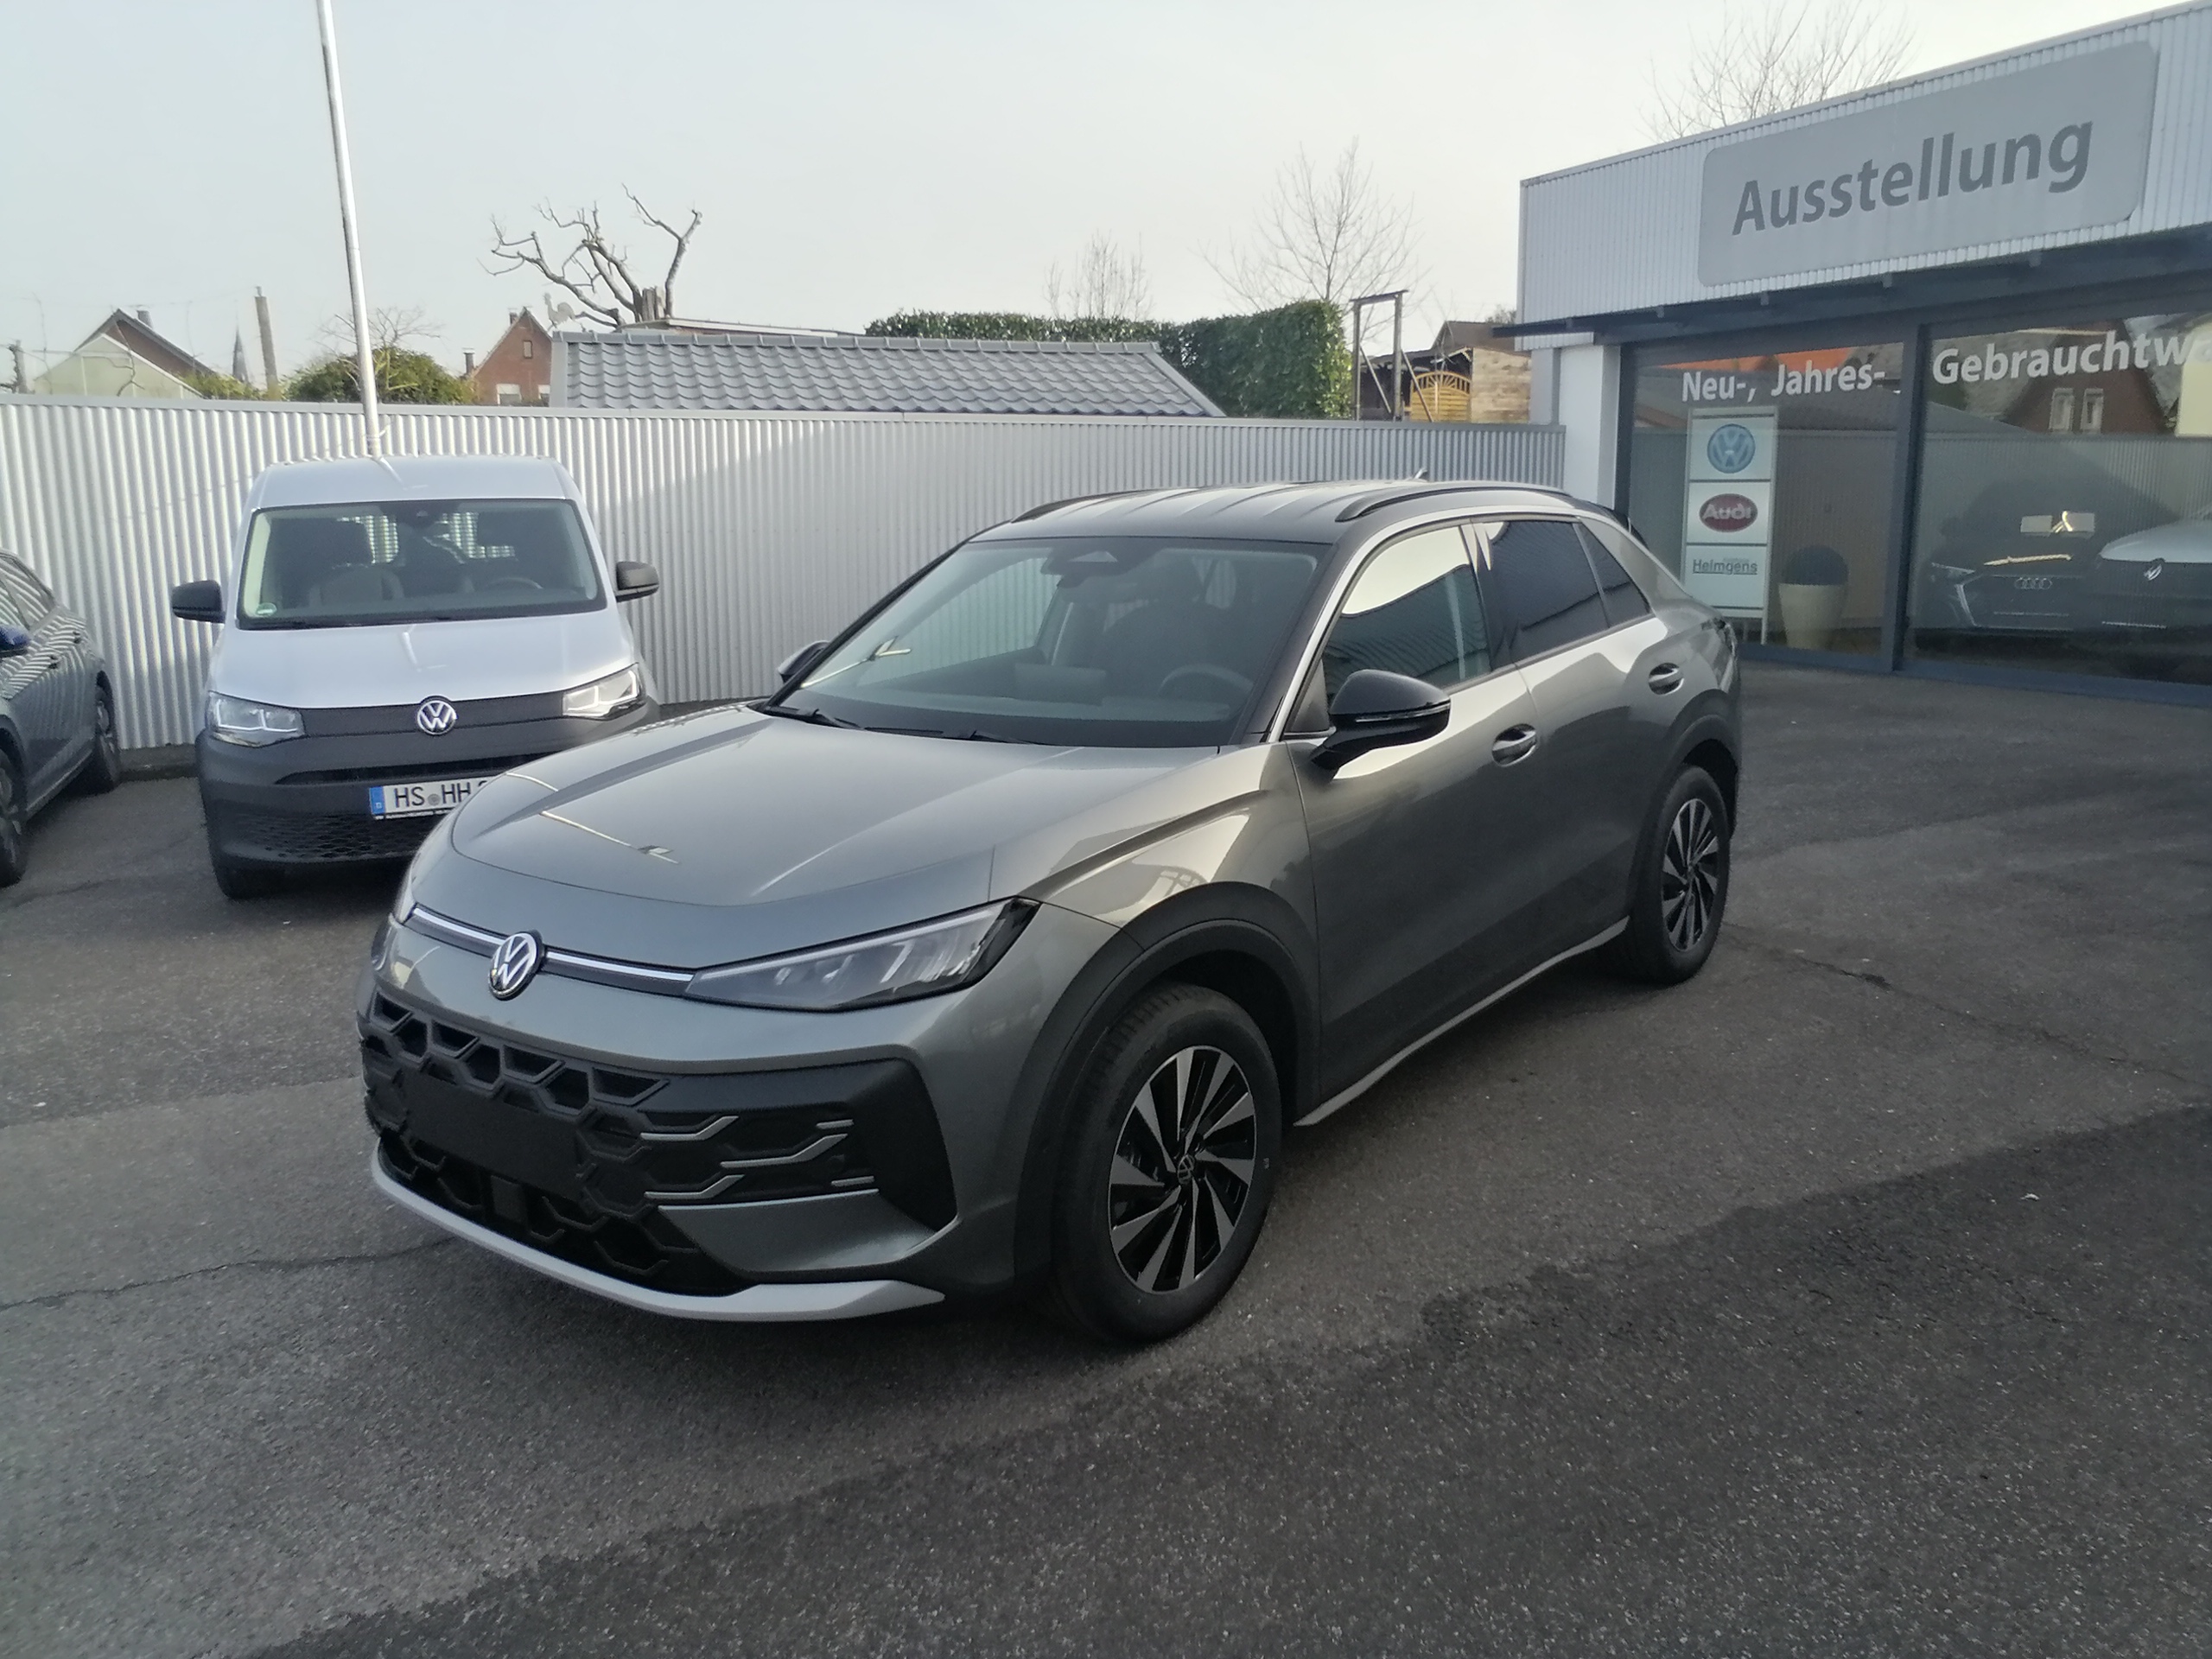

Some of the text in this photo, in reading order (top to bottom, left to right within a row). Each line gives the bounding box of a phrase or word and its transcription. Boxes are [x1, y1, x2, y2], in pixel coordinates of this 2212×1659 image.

[1732, 121, 2093, 236] Ausstellung
[1681, 371, 1757, 404] Neu-,
[1771, 359, 1885, 397] Jahres-
[1701, 503, 1752, 520] Audi
[418, 701, 456, 734] VW
[394, 786, 425, 808] HS
[489, 933, 537, 994] VW
